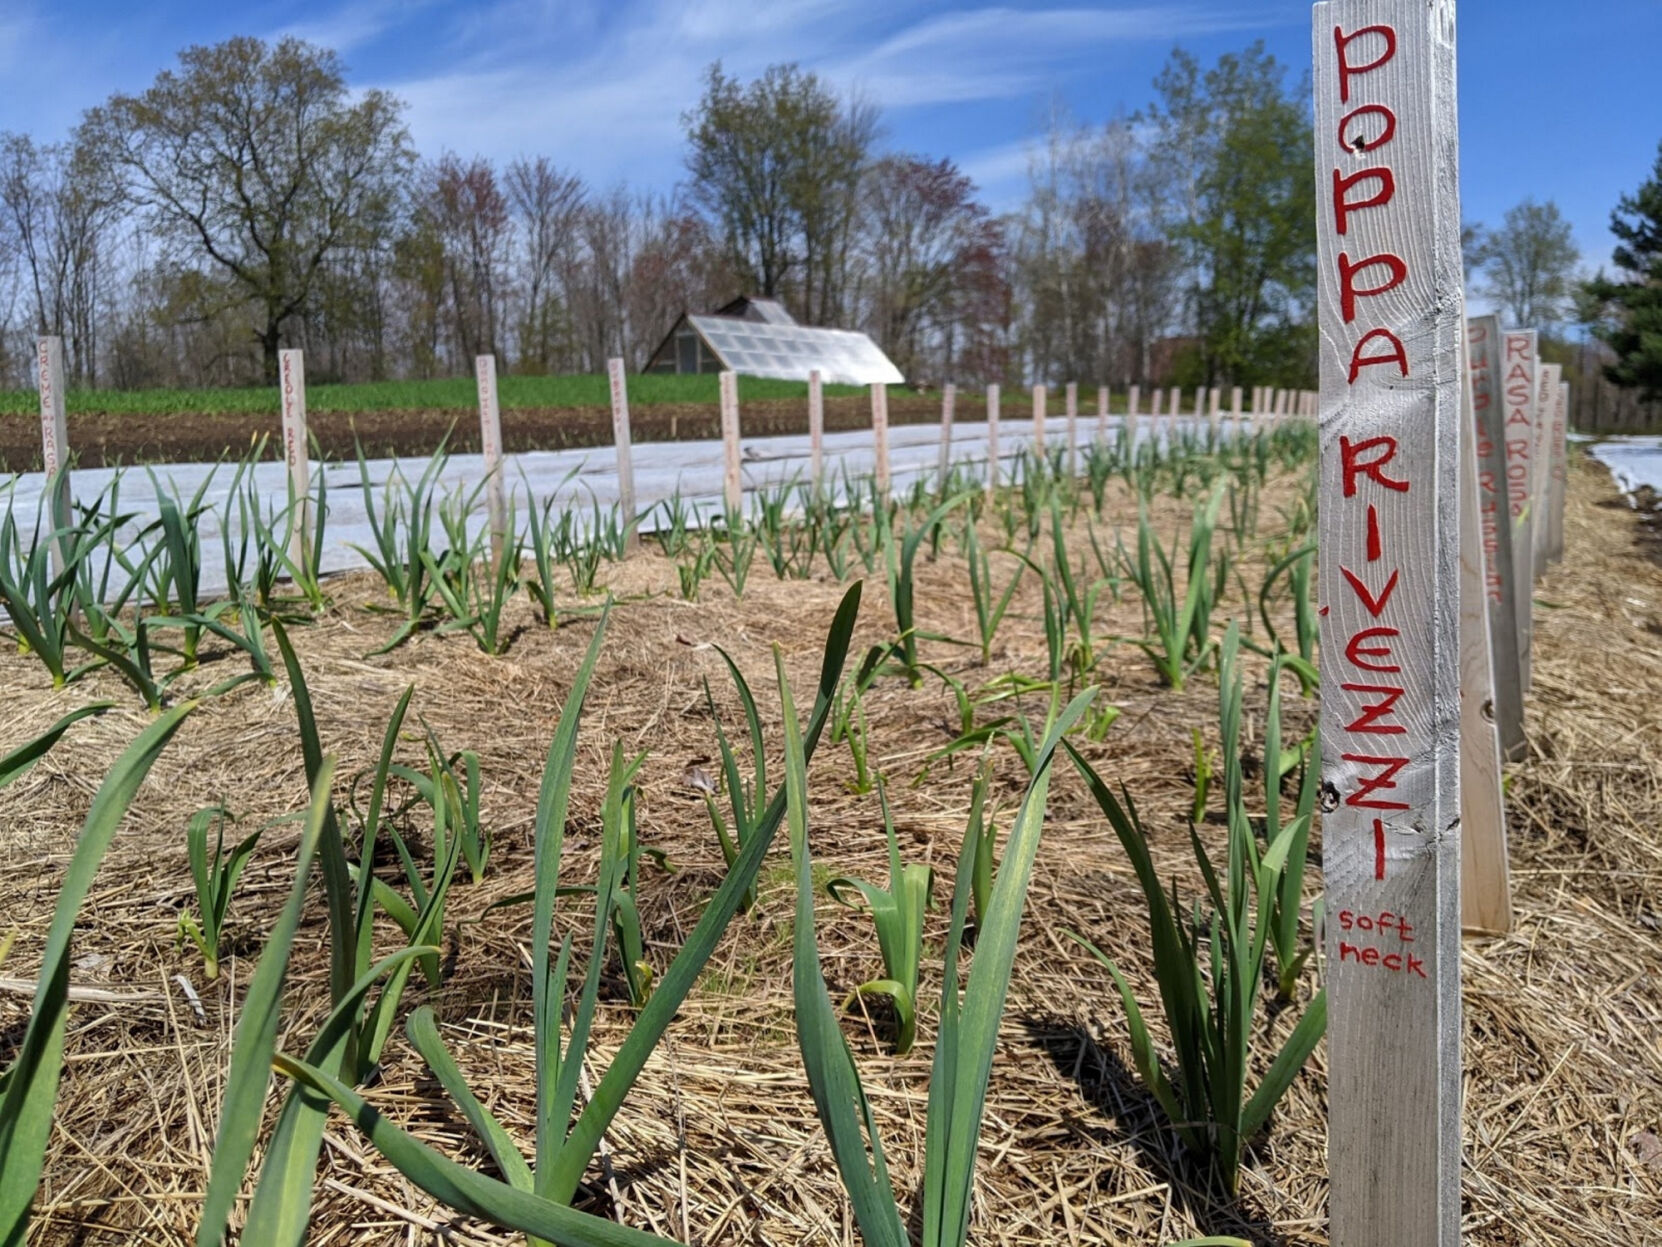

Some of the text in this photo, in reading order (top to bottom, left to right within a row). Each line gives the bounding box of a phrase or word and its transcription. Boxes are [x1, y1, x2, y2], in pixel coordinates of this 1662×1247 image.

[38, 341, 51, 408] CREME
[1506, 336, 1531, 517] RASA ROSA
[1340, 436, 1411, 880] RIVEZZI
[1340, 911, 1414, 941] soft
[1340, 943, 1427, 978] neck
